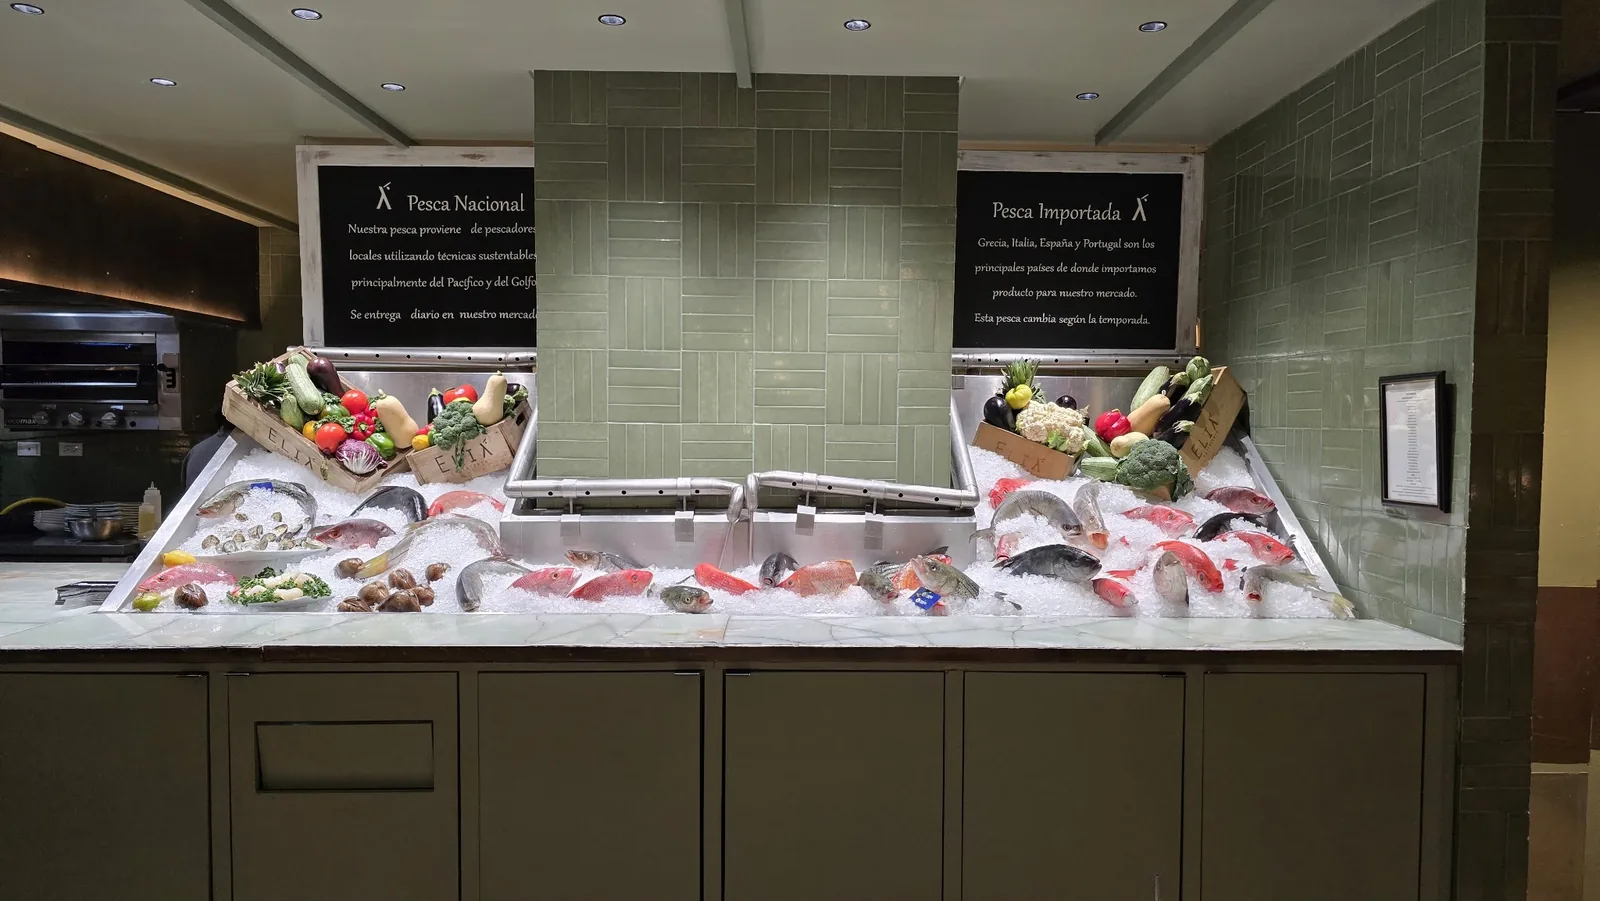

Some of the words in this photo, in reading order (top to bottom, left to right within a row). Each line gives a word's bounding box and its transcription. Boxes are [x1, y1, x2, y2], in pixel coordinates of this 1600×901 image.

[407, 194, 451, 212] Pesca
[454, 193, 526, 212] Nacional
[993, 202, 1034, 219] Pesca
[1039, 202, 1121, 226] Importada
[348, 224, 388, 235] Nuestra
[390, 227, 418, 238] pesca
[420, 225, 462, 238] proviene
[471, 223, 483, 234] de
[977, 238, 1010, 249] Grecia,
[1012, 238, 1038, 249] Italia,
[1040, 238, 1073, 251] España
[1074, 241, 1081, 250] y
[1083, 238, 1122, 252] Portugal
[1123, 241, 1140, 249] son
[1142, 239, 1155, 249] los
[350, 249, 382, 261] locales
[384, 250, 435, 261] utilizando
[437, 252, 477, 261] técnicas
[479, 248, 537, 261] sustentables
[974, 262, 1025, 275] principales
[1027, 264, 1055, 275] países
[1056, 262, 1068, 273] de
[1070, 262, 1100, 273] donde
[1101, 264, 1157, 275] importamos
[351, 276, 428, 291] principalmente
[430, 277, 445, 288] del
[447, 276, 484, 291] Pacífico
[485, 279, 492, 290] y
[494, 276, 509, 287] del
[511, 276, 537, 290] Golfo
[992, 286, 1034, 300] producto
[1036, 289, 1057, 300] para
[1059, 288, 1095, 298] nuestro
[1096, 287, 1138, 299] mercado.
[350, 309, 362, 320] Se
[364, 310, 402, 323] entrega
[411, 308, 440, 320] diario
[442, 312, 455, 320] en
[459, 310, 497, 319] nuestro
[974, 313, 995, 324] Esta
[996, 315, 1022, 326] pesca
[1023, 313, 1057, 325] cambia
[1058, 314, 1087, 327] según
[1088, 313, 1097, 324] la
[1098, 314, 1151, 327] temporada.
